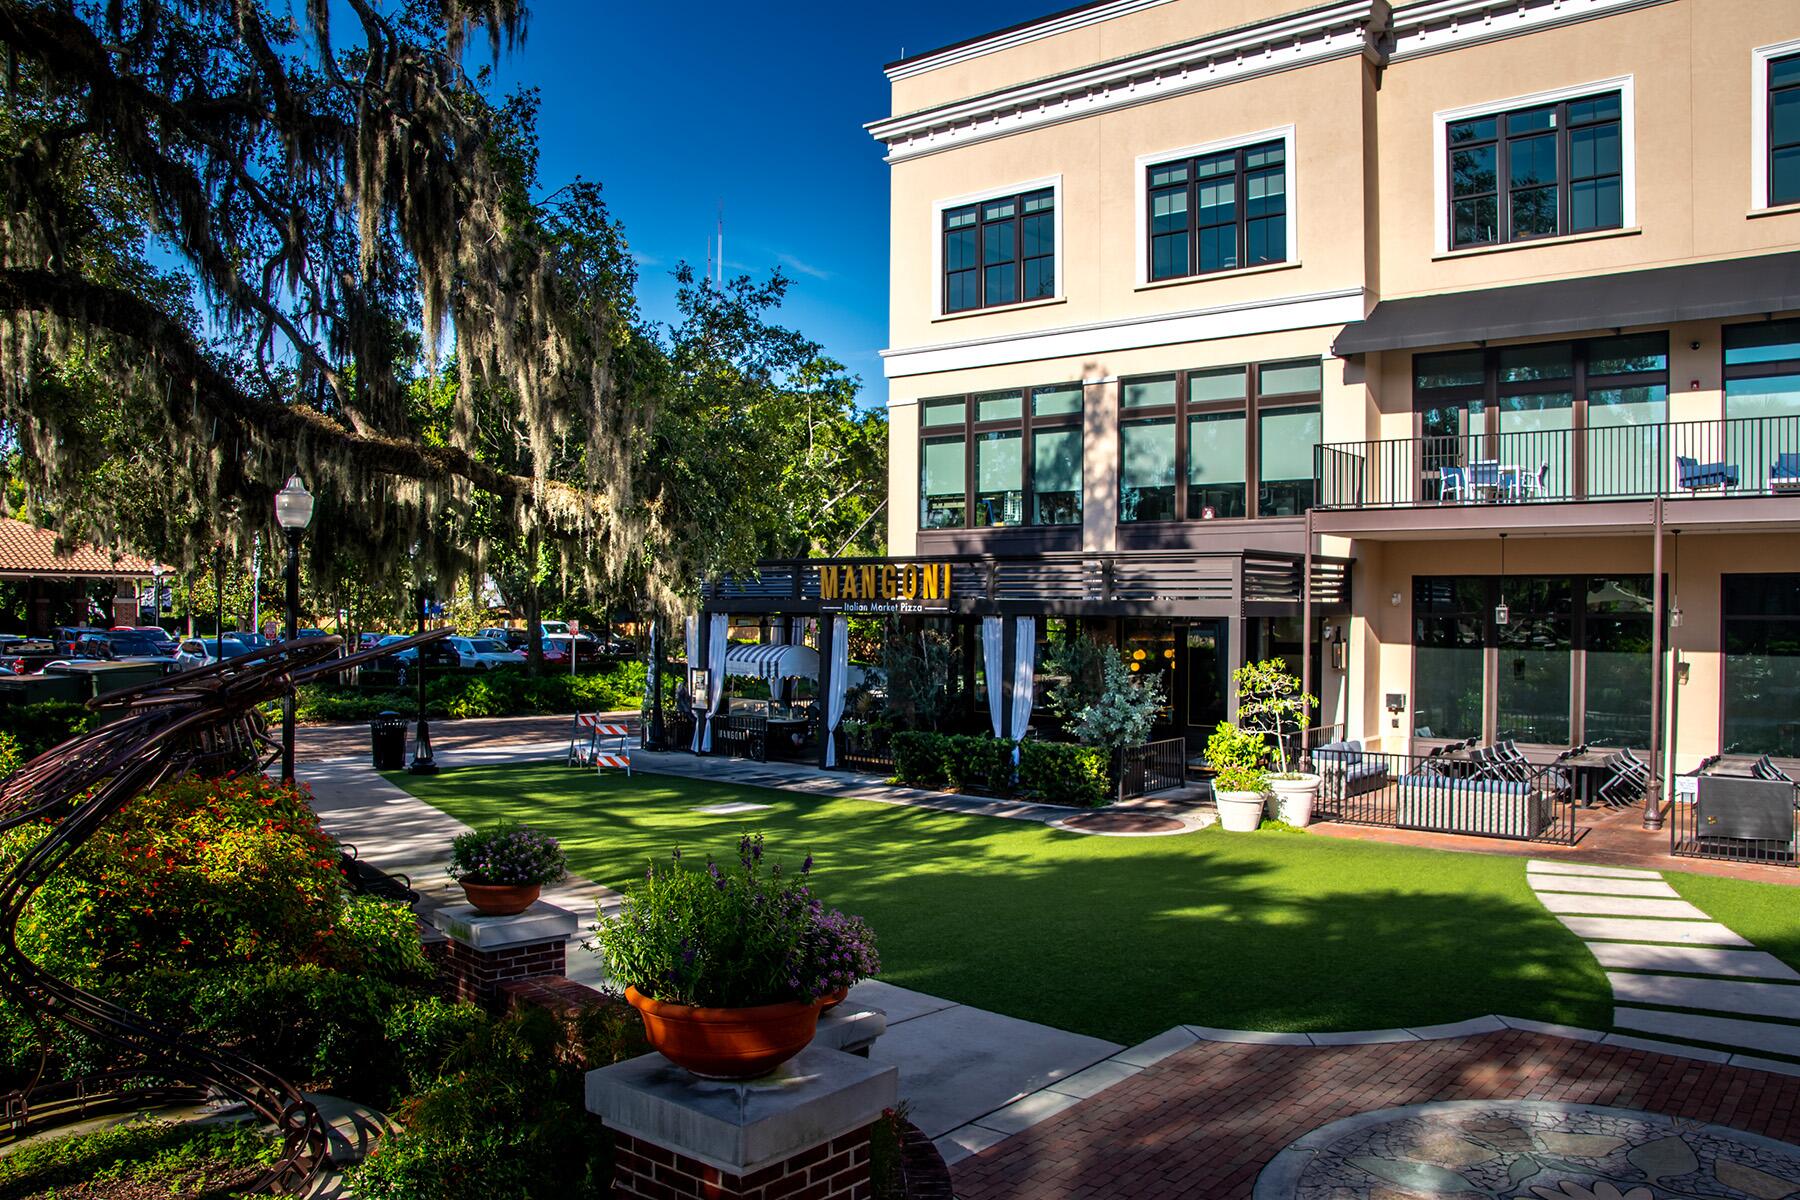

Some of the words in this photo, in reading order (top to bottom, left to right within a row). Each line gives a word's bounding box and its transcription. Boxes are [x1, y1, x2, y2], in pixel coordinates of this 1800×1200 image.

[820, 563, 951, 600] MANGONI
[844, 602, 868, 612] Italian
[870, 602, 898, 612] Market
[900, 602, 923, 612] Pizza
